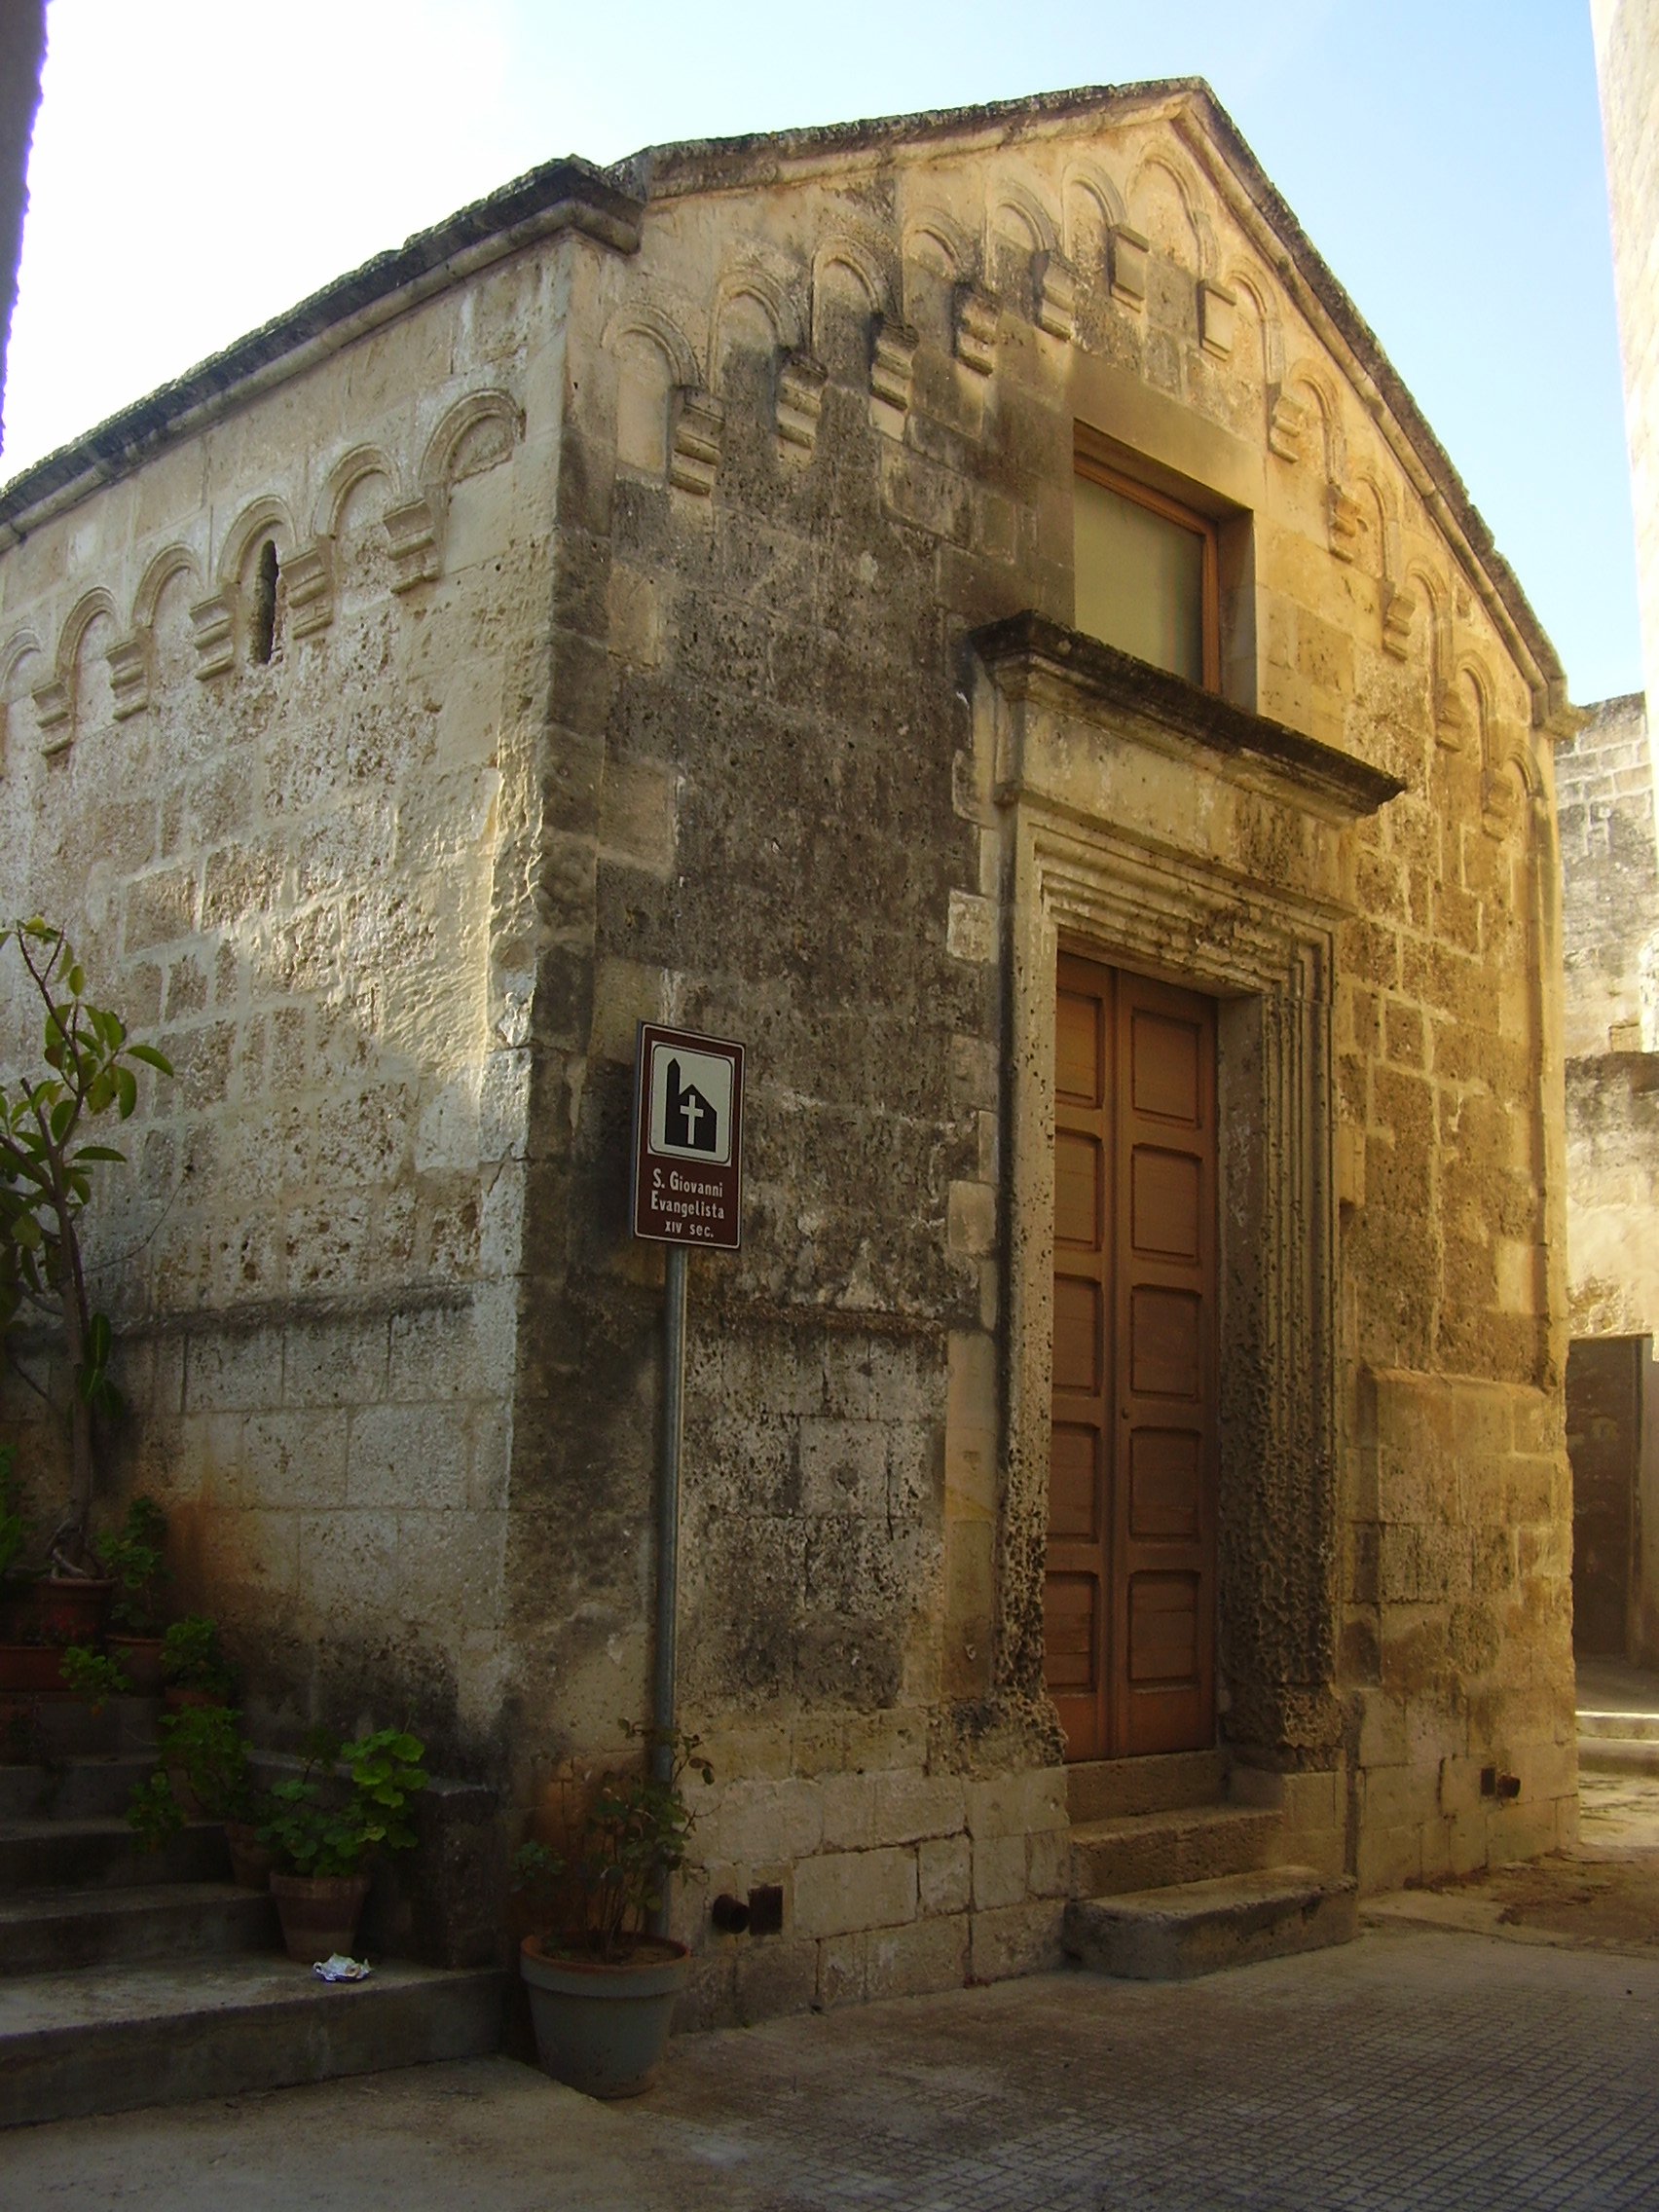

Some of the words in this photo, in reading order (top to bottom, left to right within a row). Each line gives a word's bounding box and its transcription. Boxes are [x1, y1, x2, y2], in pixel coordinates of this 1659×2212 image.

[653, 1168, 665, 1189] S.
[670, 1170, 722, 1198] Giovanni
[651, 1190, 724, 1219] Evangelista
[665, 1221, 682, 1234] XIV
[689, 1224, 714, 1237] sec.
